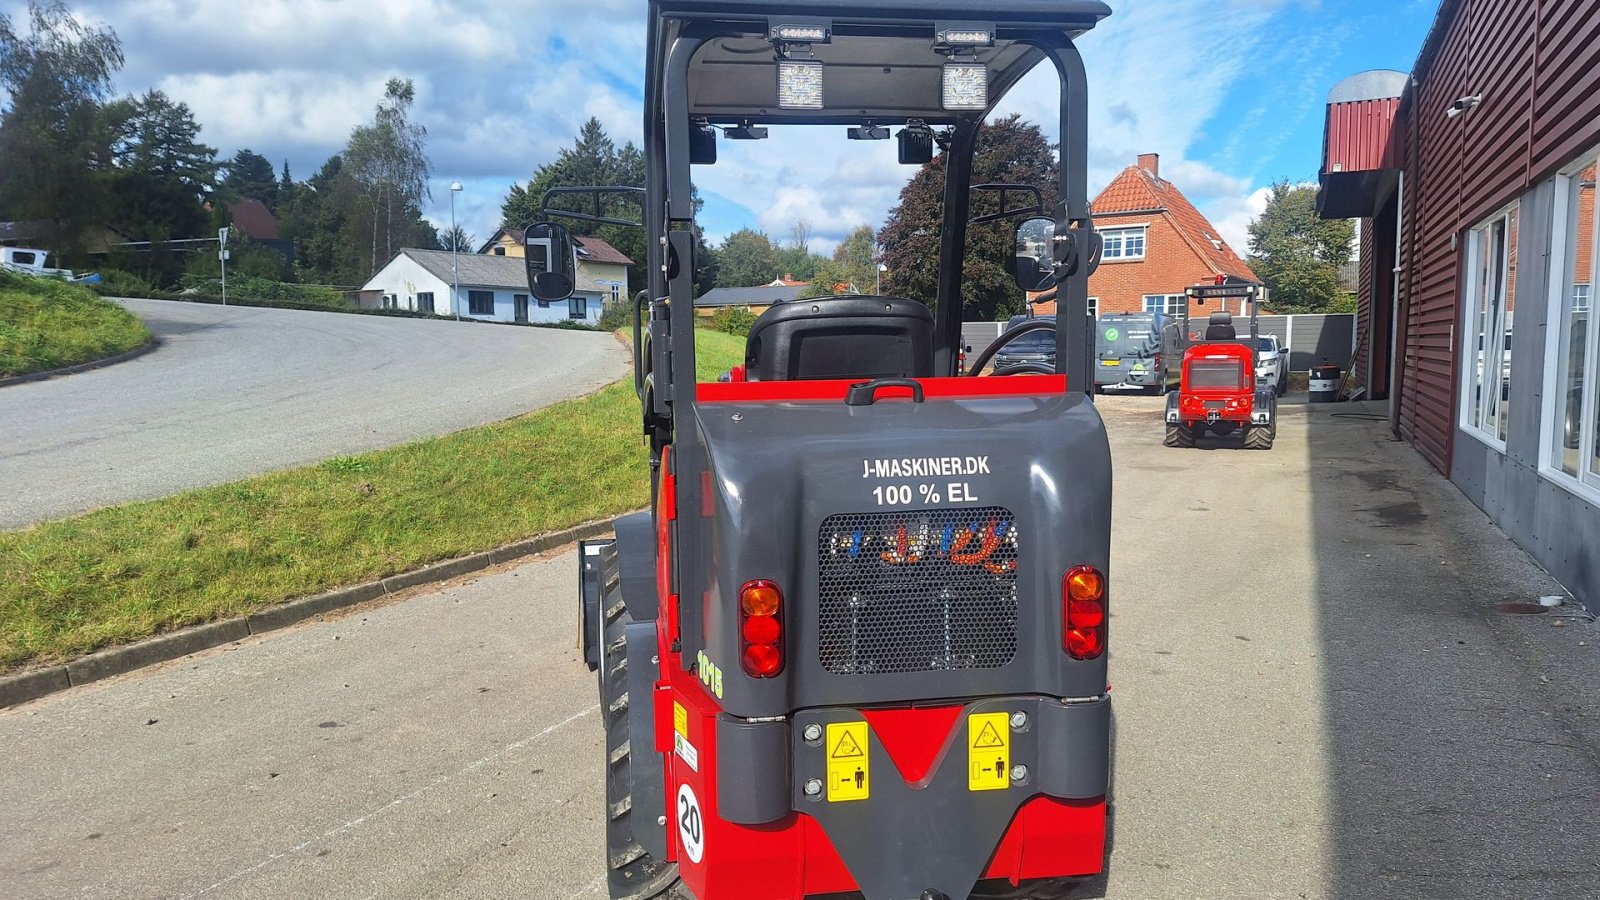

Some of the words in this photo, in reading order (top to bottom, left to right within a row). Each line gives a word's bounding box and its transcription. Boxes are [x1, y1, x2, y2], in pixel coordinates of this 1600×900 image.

[863, 455, 991, 478] J-MASKINER.DK
[872, 484, 913, 506] 100
[918, 483, 941, 504] %
[947, 482, 979, 503] EL
[697, 649, 723, 700] 1015
[680, 794, 701, 845] 20
